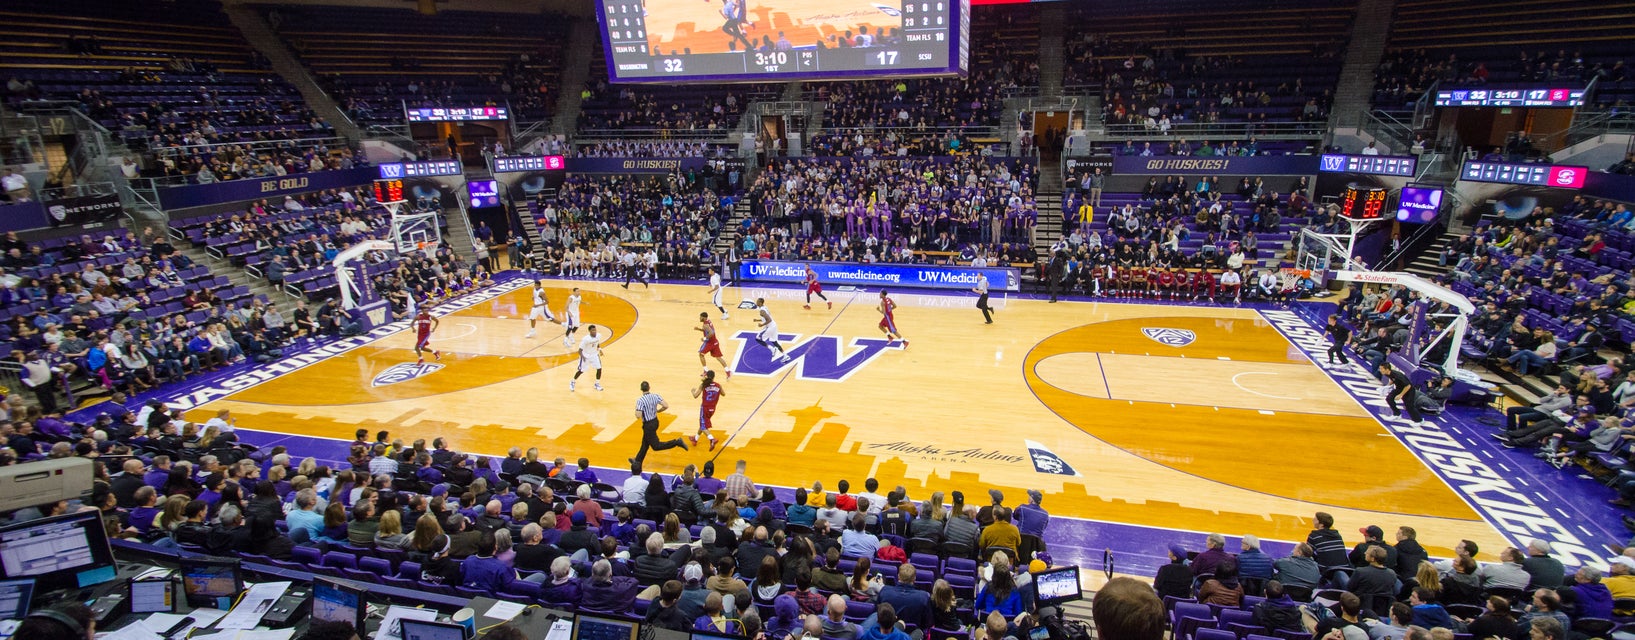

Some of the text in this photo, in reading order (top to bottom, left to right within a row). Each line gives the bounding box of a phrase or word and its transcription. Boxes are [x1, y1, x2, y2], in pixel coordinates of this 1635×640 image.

[905, 4, 914, 13] 15
[905, 18, 914, 26] 23
[923, 16, 928, 25] 2
[907, 34, 921, 42] TEAM
[756, 52, 787, 65] 3:10
[877, 51, 898, 65] 17
[663, 58, 683, 73] 32
[1470, 90, 1487, 100] 32
[1495, 91, 1519, 99] 3:10
[1529, 90, 1547, 99] 17
[623, 160, 636, 169] GO
[1146, 159, 1163, 170] GO
[261, 177, 309, 192] BE GOLD
[1369, 191, 1386, 201] 3:10
[65, 201, 121, 214] NETWORKS
[1363, 201, 1382, 218] 32
[1412, 202, 1436, 210] Medicine
[749, 264, 808, 278] UW Medicin
[828, 270, 900, 283] uwmedicine.org
[918, 271, 940, 283] UW
[366, 306, 387, 327] W
[728, 330, 910, 382] W
[868, 441, 1026, 464] Alaska Airlines
[921, 456, 967, 464] ARENA
